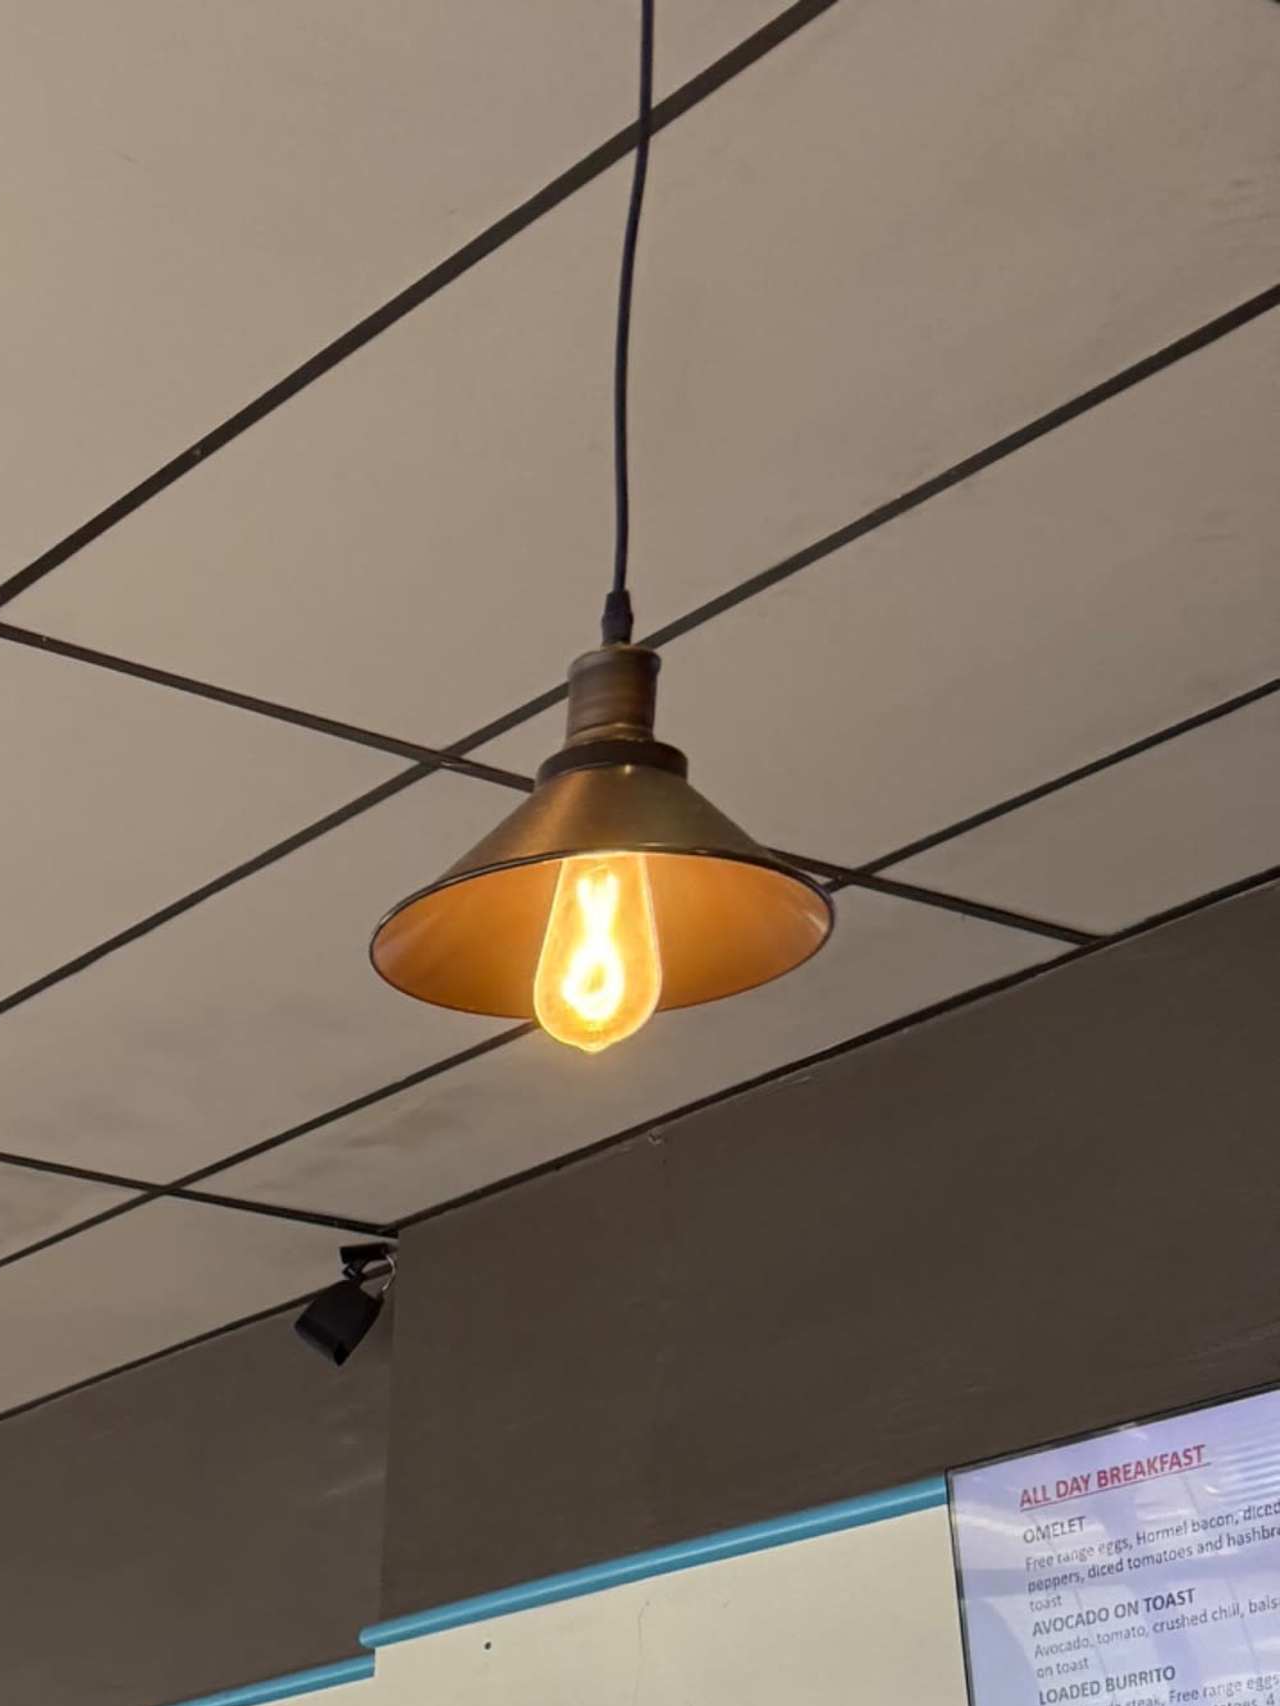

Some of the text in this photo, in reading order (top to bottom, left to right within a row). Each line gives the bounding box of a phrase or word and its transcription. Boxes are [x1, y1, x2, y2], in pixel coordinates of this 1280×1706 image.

[1020, 1444, 1206, 1507] ALL DAY BREAKFAST
[1023, 1515, 1086, 1544] OMELET
[1137, 1521, 1188, 1545] Hormel
[1192, 1512, 1239, 1530] bacon,
[1027, 1533, 1222, 1594] peppers, diced tomatoes and
[1029, 1595, 1062, 1612] toast
[1032, 1588, 1196, 1637] AVOCADO ON TOAST
[1152, 1610, 1208, 1633] crushed
[1036, 1657, 1090, 1679] on toast
[1040, 1665, 1176, 1706] LOADED BURRITO
[1169, 1689, 1199, 1703] Free
[1202, 1679, 1242, 1698] range
[1266, 1693, 1275, 1706] 4
